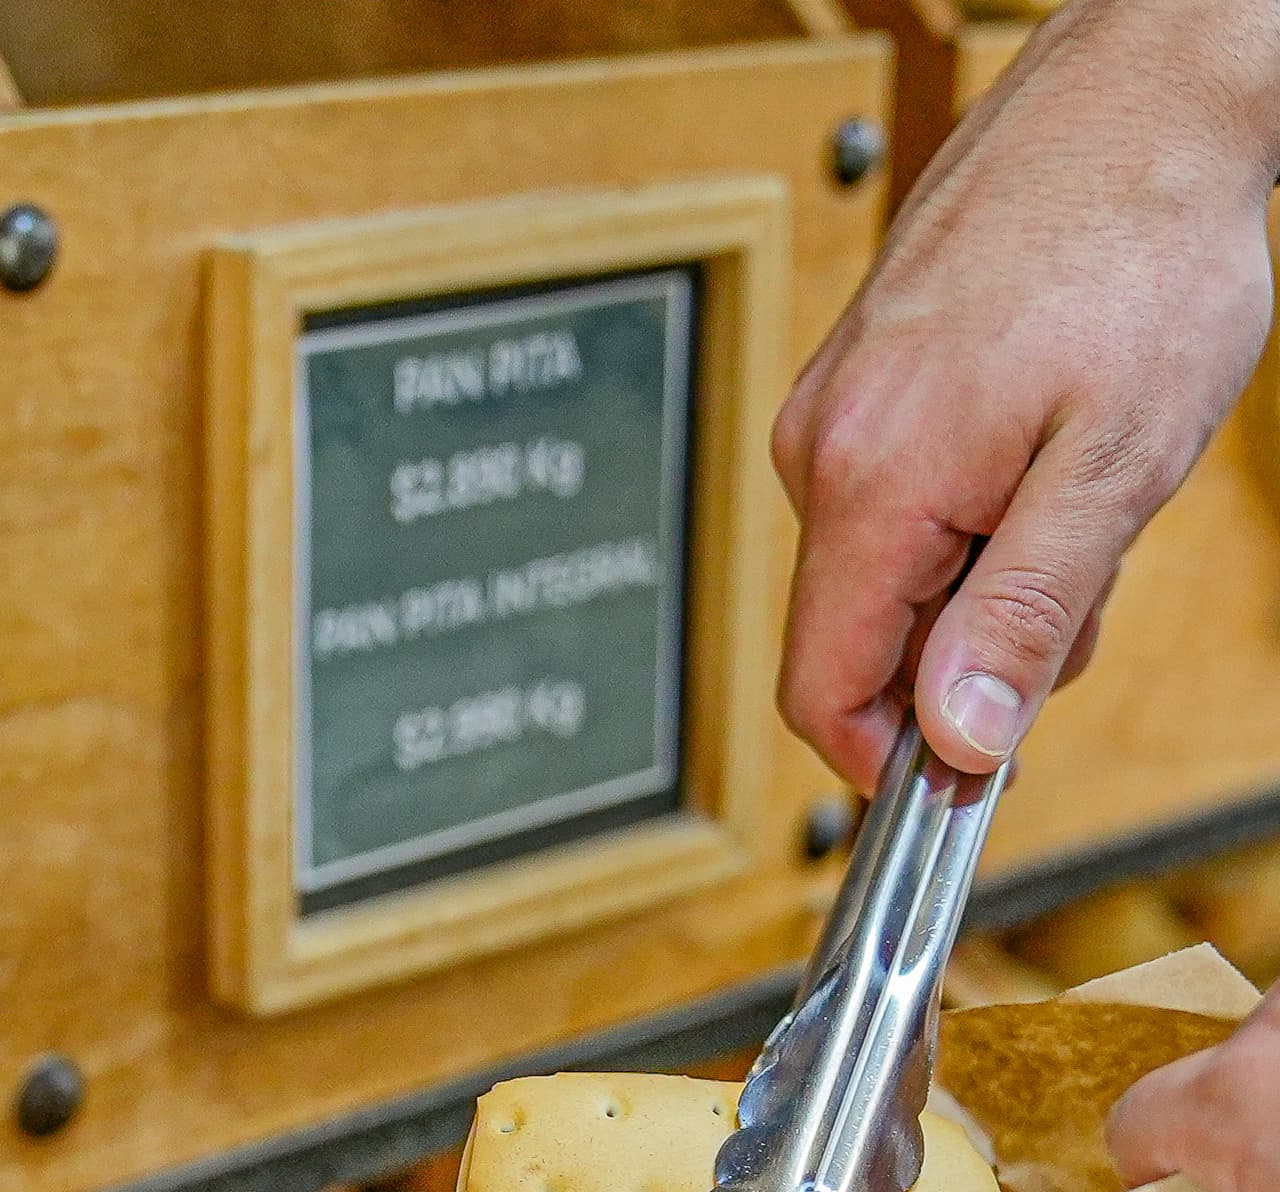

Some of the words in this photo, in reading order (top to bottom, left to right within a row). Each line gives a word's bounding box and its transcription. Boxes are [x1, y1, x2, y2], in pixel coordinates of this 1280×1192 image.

[393, 354, 484, 415] PAN
[488, 331, 583, 396] PITA
[315, 604, 397, 658] PAN
[400, 577, 484, 636] PITA
